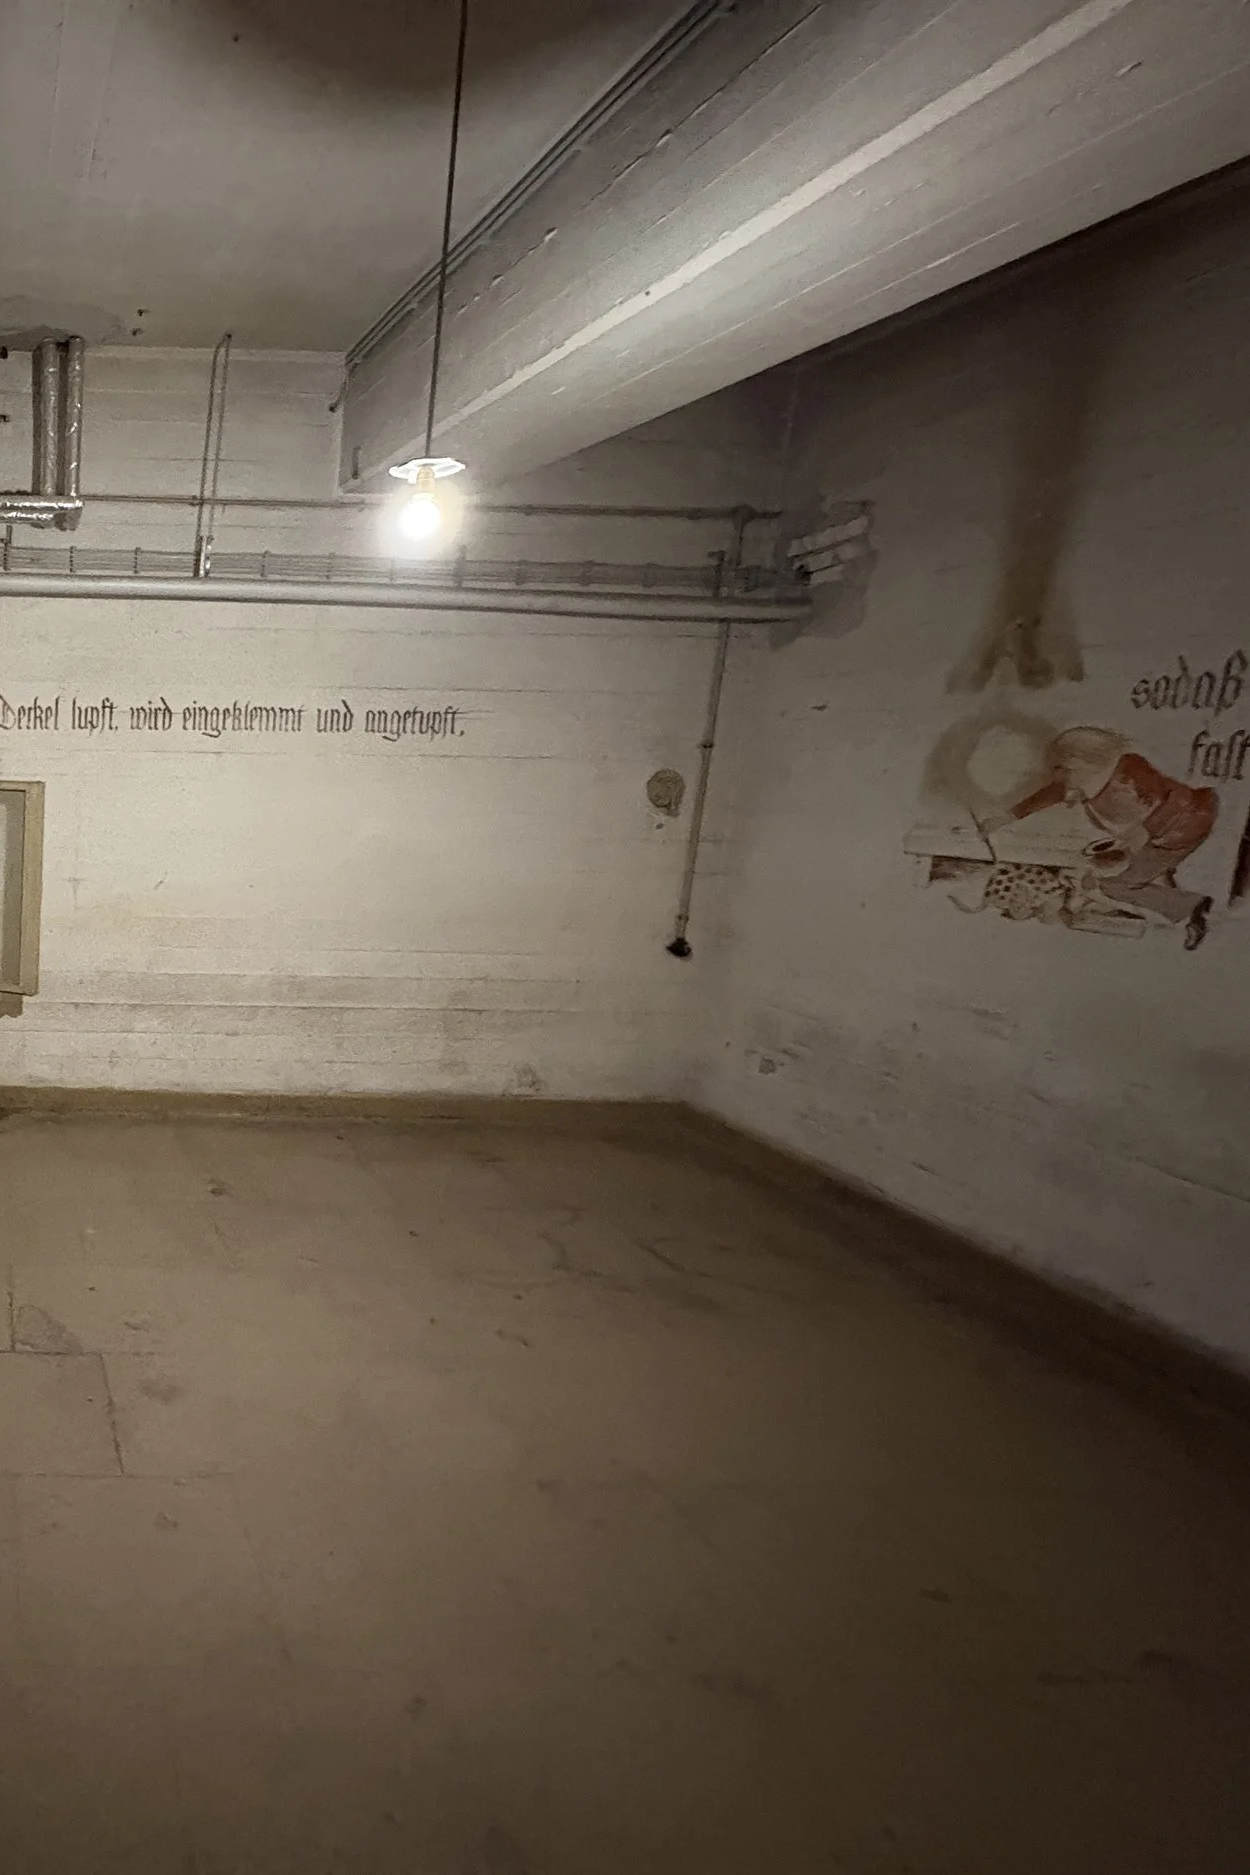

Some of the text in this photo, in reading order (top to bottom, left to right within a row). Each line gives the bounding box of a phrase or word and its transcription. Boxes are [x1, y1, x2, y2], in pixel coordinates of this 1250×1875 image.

[1128, 648, 1249, 717] sodaß
[129, 697, 173, 731] wird
[182, 699, 306, 739] eingeklemmt
[316, 698, 354, 733] und
